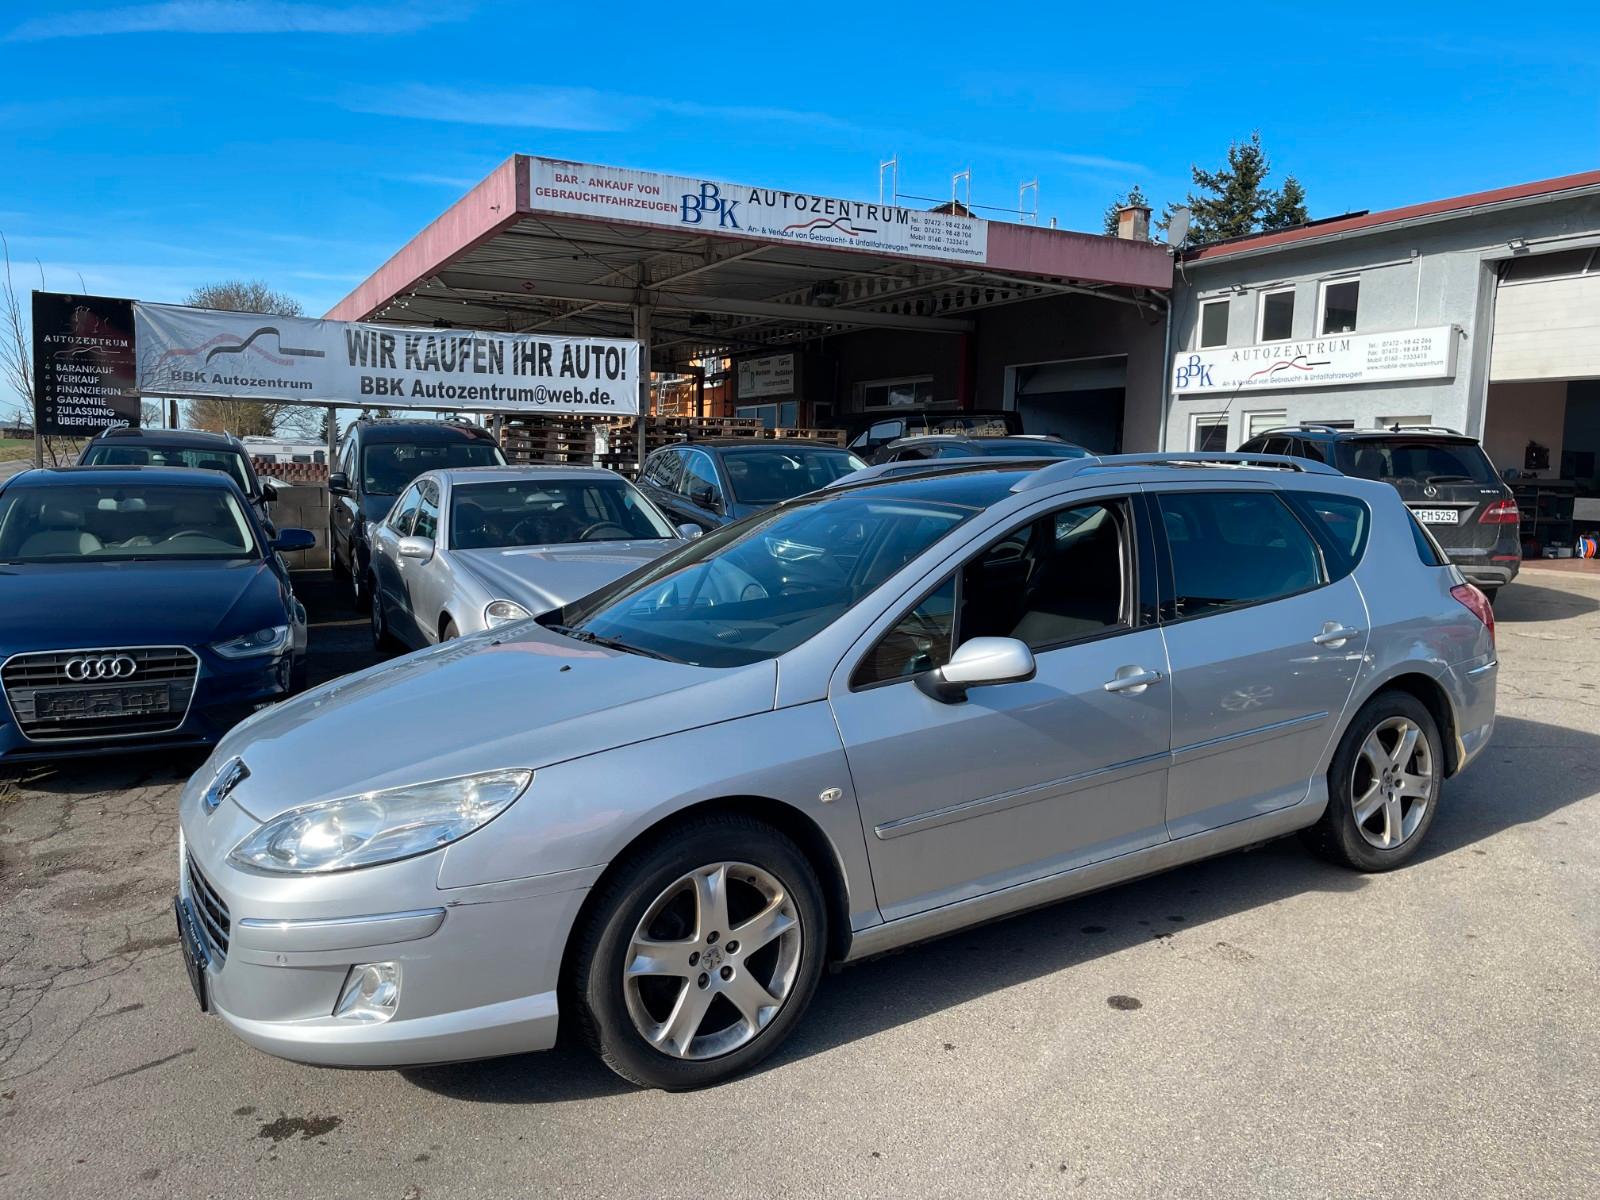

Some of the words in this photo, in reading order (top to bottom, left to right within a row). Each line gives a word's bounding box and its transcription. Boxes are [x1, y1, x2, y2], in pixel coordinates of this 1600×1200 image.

[556, 173, 578, 184] BAR
[588, 178, 634, 192] ANKAUF
[637, 184, 660, 195] VON
[536, 187, 678, 213] GEBRAUCHTFAHRZEUGEN
[680, 182, 741, 230] BBK
[748, 189, 909, 225] AUTOZENTRUM
[768, 228, 794, 237] Verkauf
[810, 233, 847, 244] Gebraucht-
[856, 239, 908, 251] Unfallfahrzeugen
[44, 335, 128, 347] AUTOZENTRUM
[346, 329, 396, 369] WIR
[405, 334, 504, 374] KAUFEN
[513, 341, 553, 378] IHR
[560, 344, 626, 380] AUTO!
[1176, 355, 1215, 388] BBK
[1232, 340, 1351, 362] AUTOZENTRUM
[56, 364, 115, 374] BARANKAUF
[56, 375, 100, 384] VERKAUF
[171, 370, 207, 383] BBK
[212, 374, 313, 390] Autozentrum
[360, 375, 404, 397] BBK
[411, 379, 615, 405] Autozentrum@web.de.
[57, 396, 107, 406] GARANTIE
[57, 406, 115, 416] ZULASSUNG
[58, 415, 129, 428] ÜBERFÜHRUNG
[1422, 511, 1433, 520] FM
[1435, 512, 1456, 520] 5252
